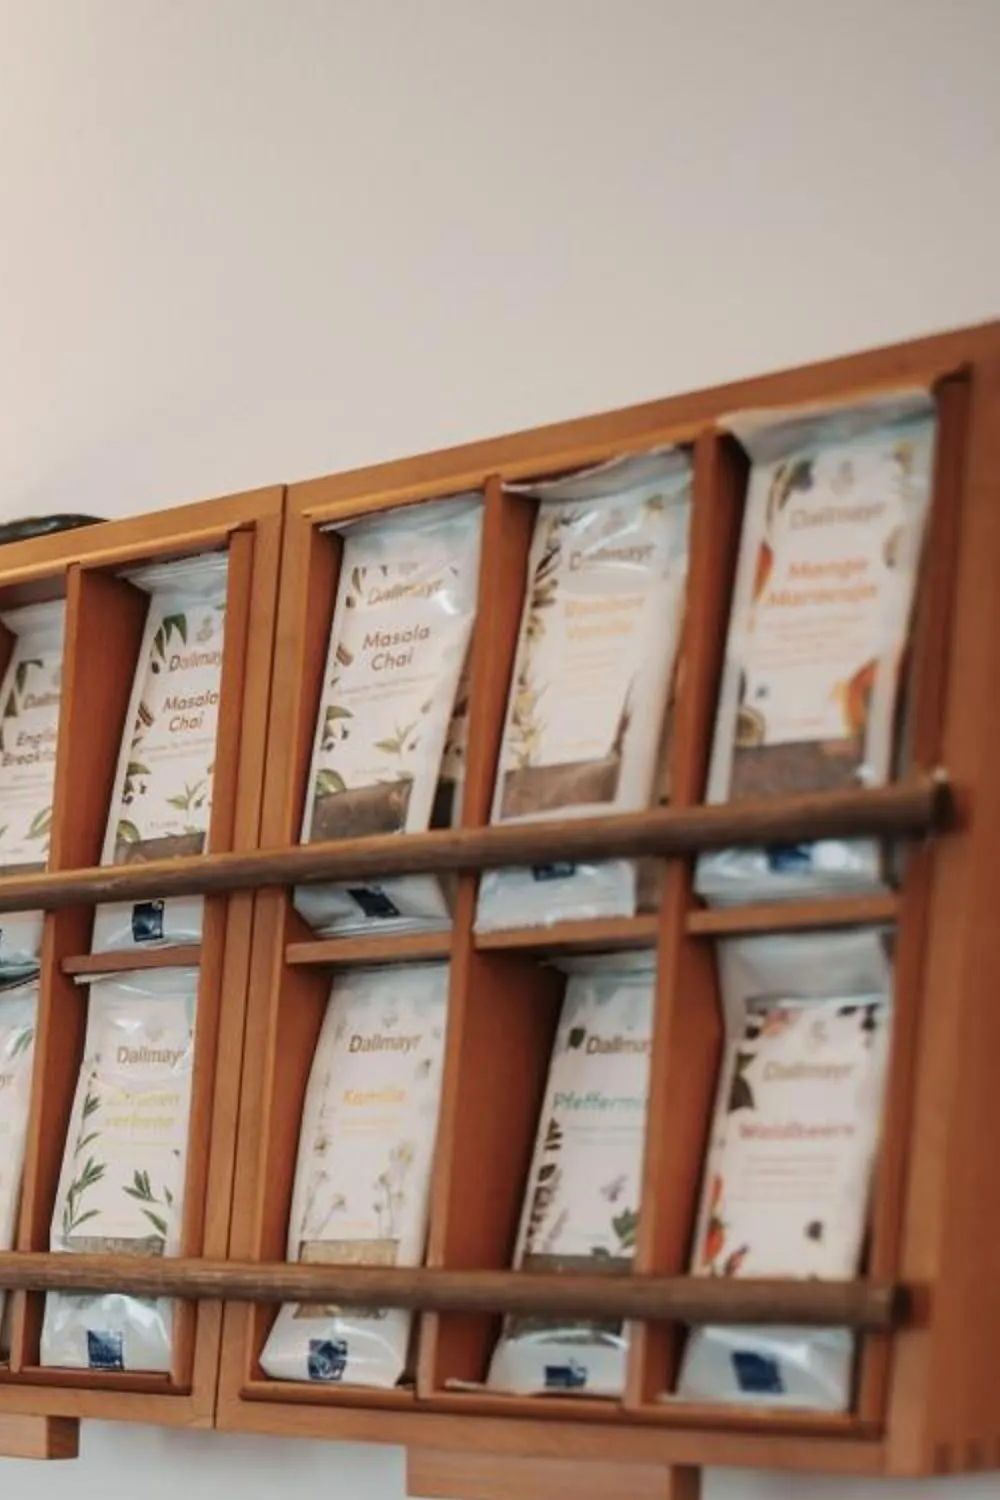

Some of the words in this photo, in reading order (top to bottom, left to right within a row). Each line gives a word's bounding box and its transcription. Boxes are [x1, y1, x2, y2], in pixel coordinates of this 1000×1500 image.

[362, 624, 430, 650] Masala
[168, 651, 221, 672] Dallmay
[371, 646, 414, 671] Chai
[162, 690, 219, 713] Masala
[168, 711, 204, 732] Chai
[349, 1033, 422, 1055] Dallmayr
